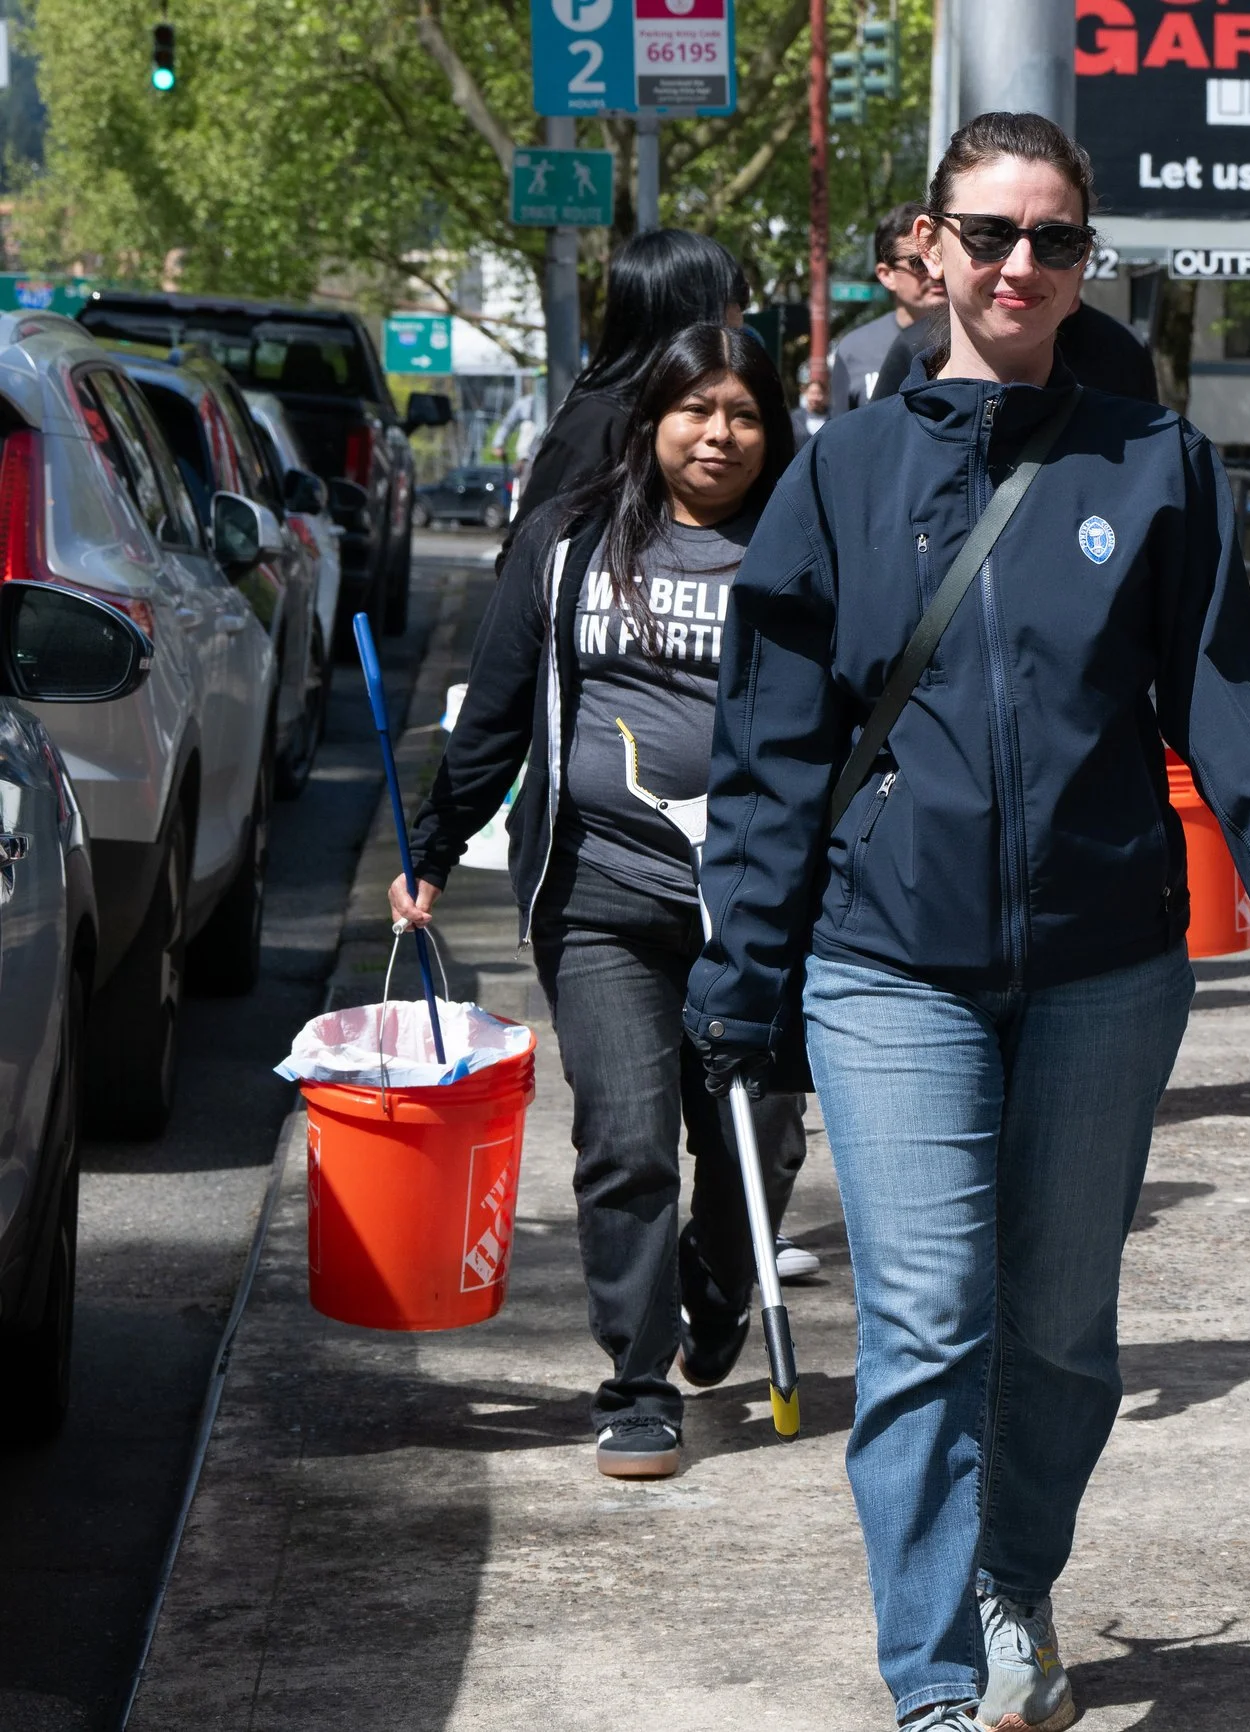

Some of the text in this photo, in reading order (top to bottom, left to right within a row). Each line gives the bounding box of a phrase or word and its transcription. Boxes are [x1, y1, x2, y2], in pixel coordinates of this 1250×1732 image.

[567, 39, 606, 93] 2
[646, 42, 717, 63] 66195
[1139, 153, 1202, 189] Let
[586, 571, 729, 622] W BELI
[579, 614, 610, 655] IN
